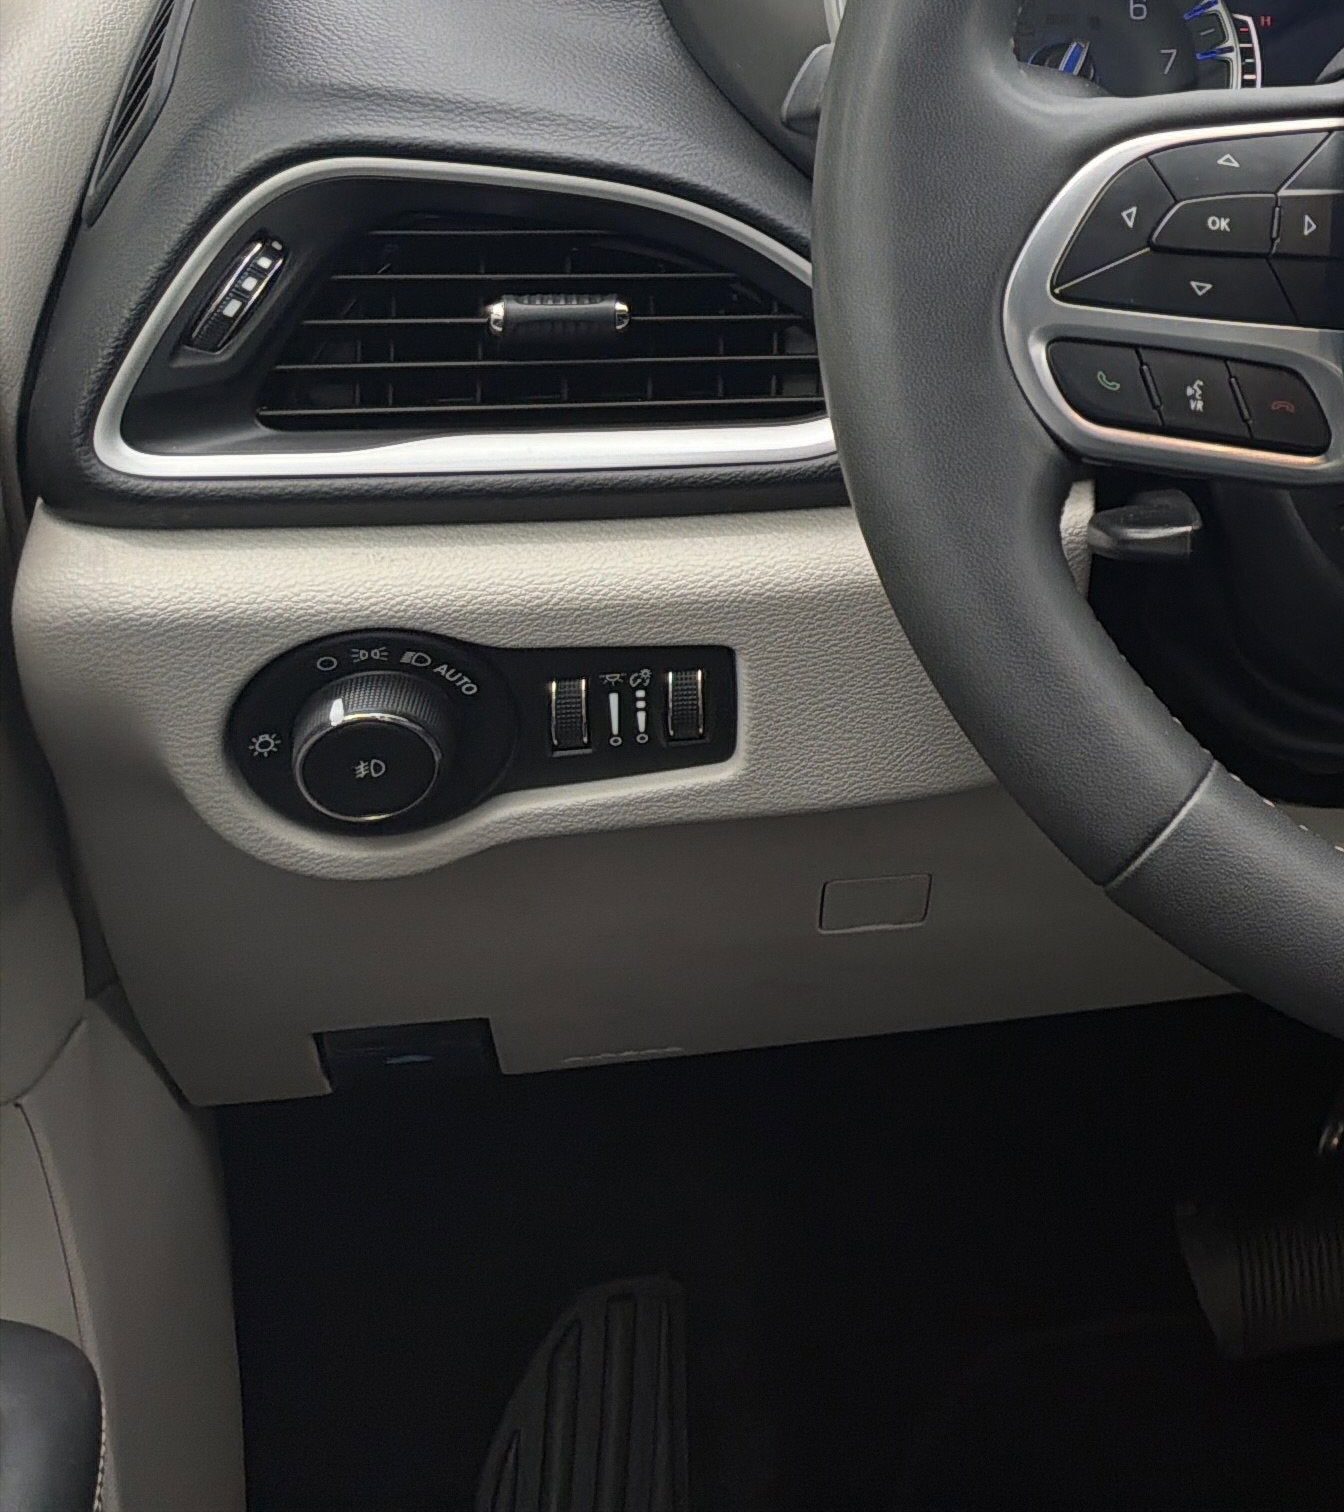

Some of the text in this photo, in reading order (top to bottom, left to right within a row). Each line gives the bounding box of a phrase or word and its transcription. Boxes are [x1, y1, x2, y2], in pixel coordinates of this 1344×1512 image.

[1260, 16, 1271, 26] H
[1160, 48, 1177, 75] 7
[1207, 216, 1230, 232] OK
[1190, 400, 1204, 412] VR
[432, 664, 478, 695] AUTO
